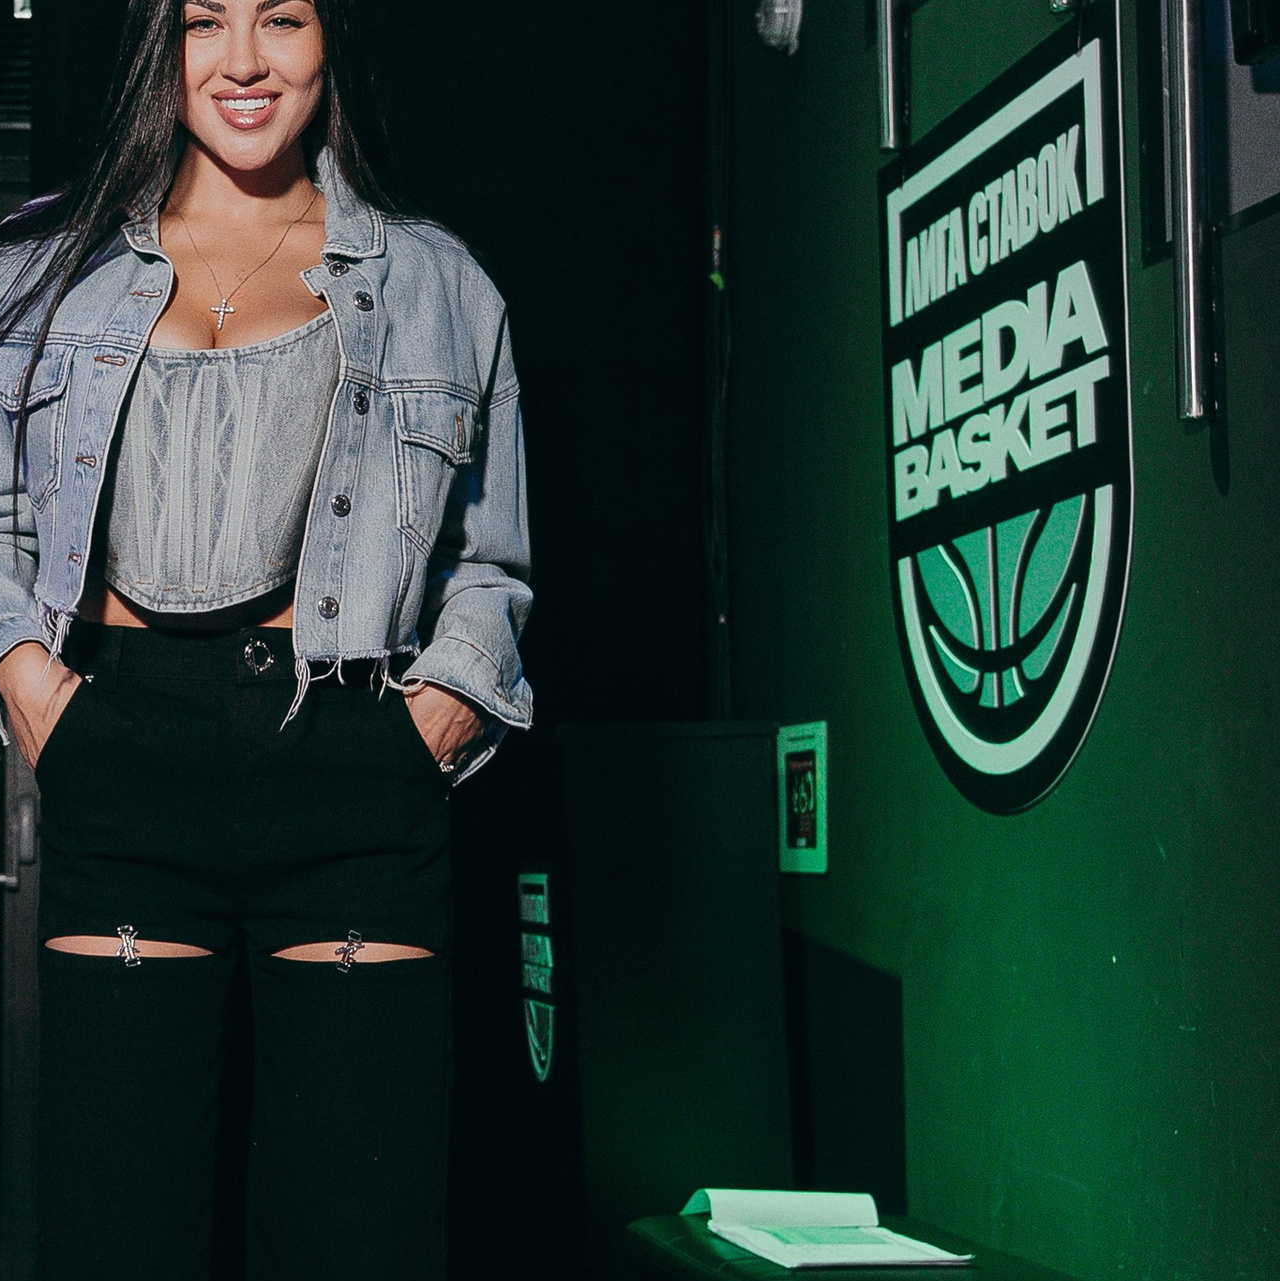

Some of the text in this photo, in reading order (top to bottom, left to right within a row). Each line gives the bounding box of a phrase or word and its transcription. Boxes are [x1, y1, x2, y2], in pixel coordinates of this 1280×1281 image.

[905, 124, 1083, 318] ЛИГА СТАВОК
[891, 259, 1108, 447] MEDIA
[893, 354, 1110, 523] BASKET
